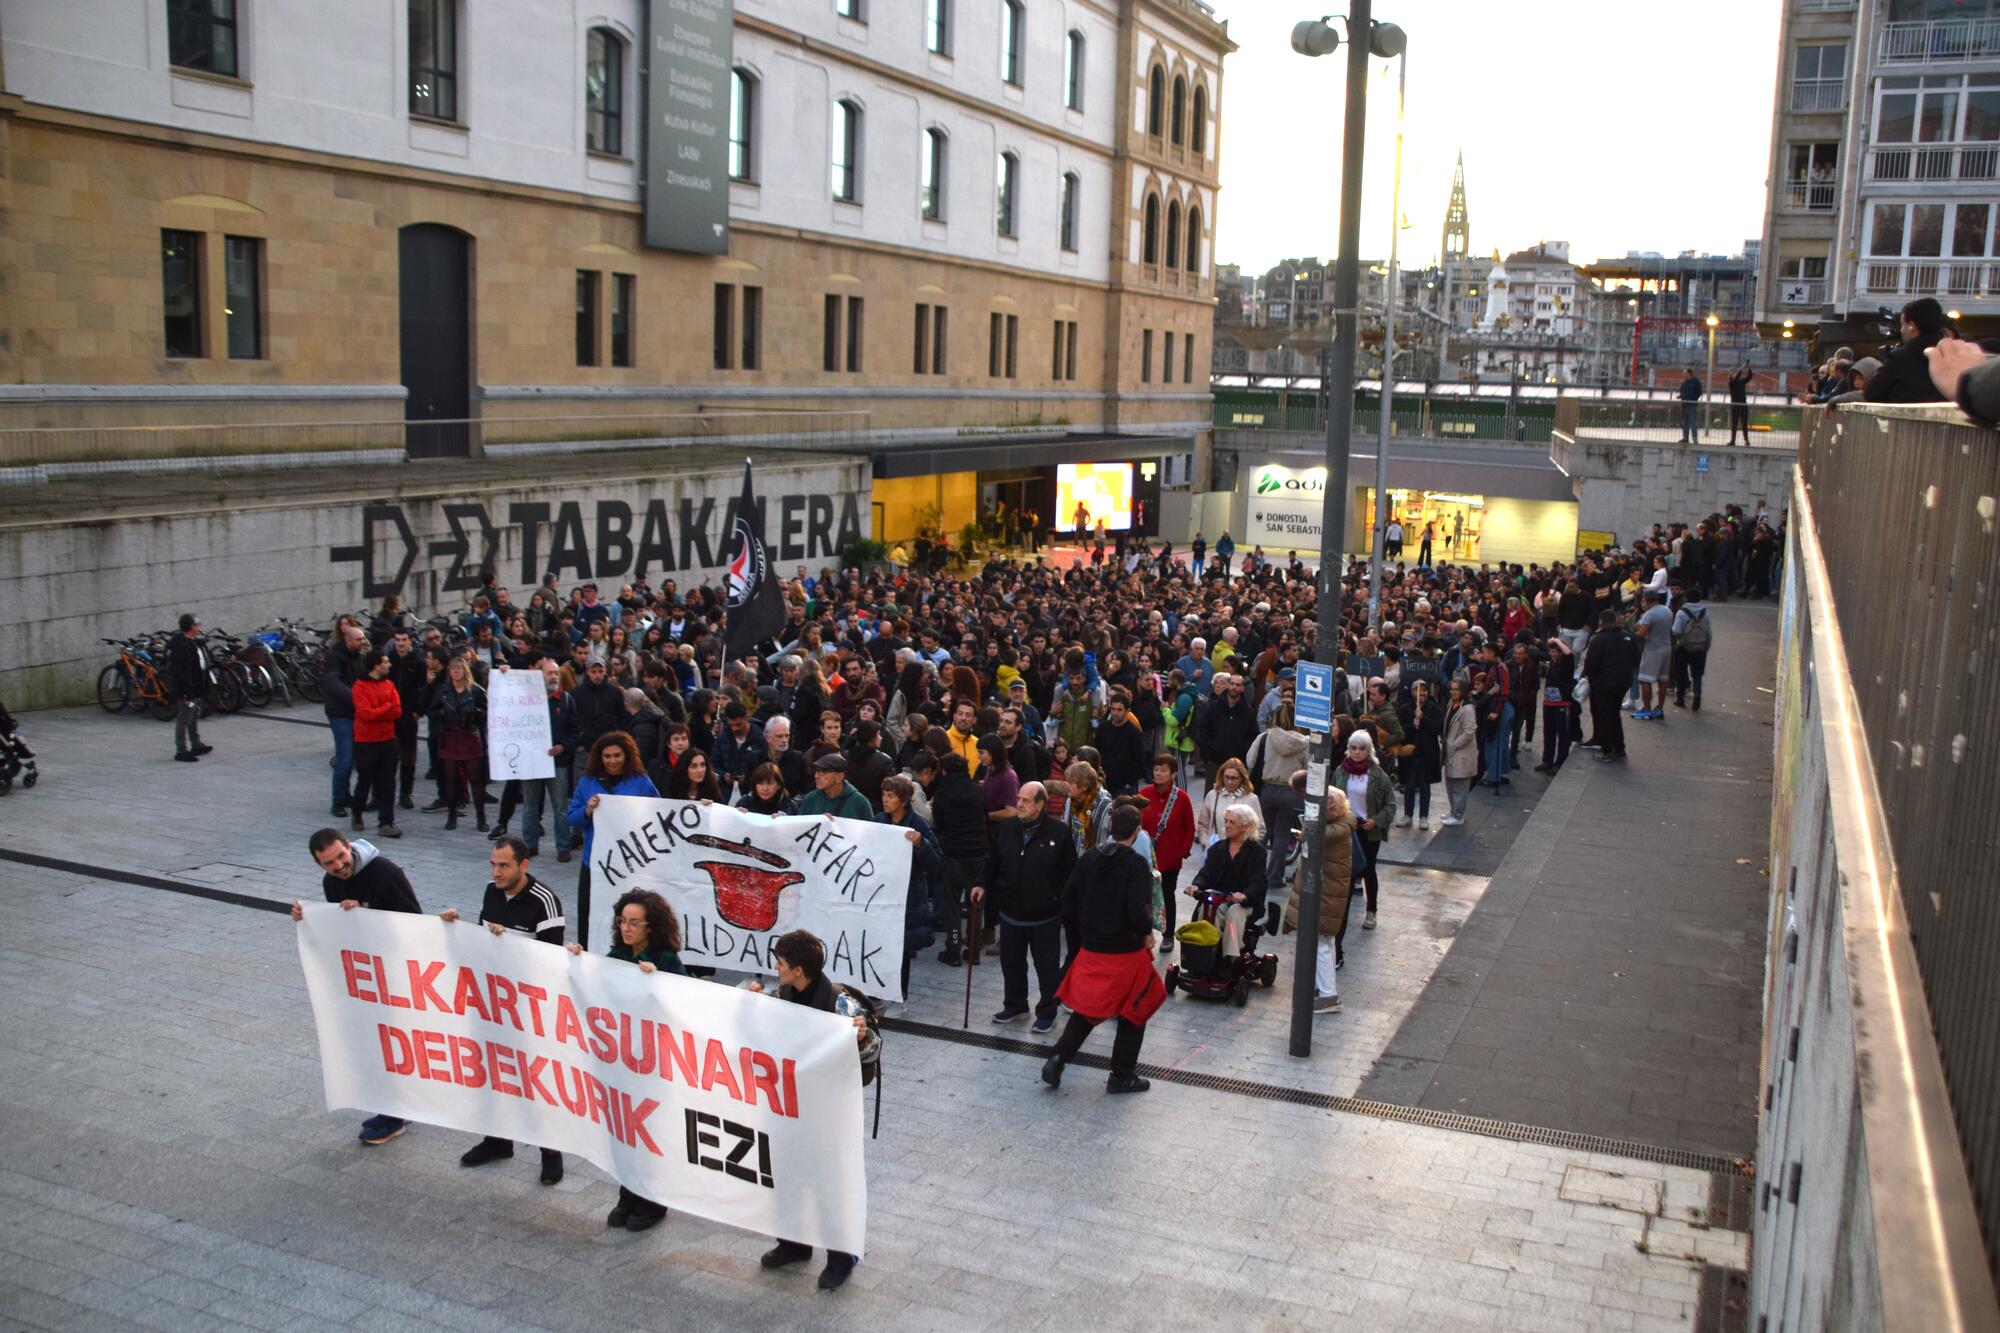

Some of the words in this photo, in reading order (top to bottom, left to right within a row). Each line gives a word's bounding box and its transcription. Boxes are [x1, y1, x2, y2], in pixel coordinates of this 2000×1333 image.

[1267, 513, 1307, 523] DONOSTIA
[1267, 524, 1283, 532] SAN
[1287, 525, 1322, 534] SEBASTI
[598, 804, 702, 887] KALEKO
[340, 948, 800, 1120] ELKARTASUNARI
[377, 1022, 665, 1158] DEBEKURIK
[684, 1107, 775, 1189] EZ!
